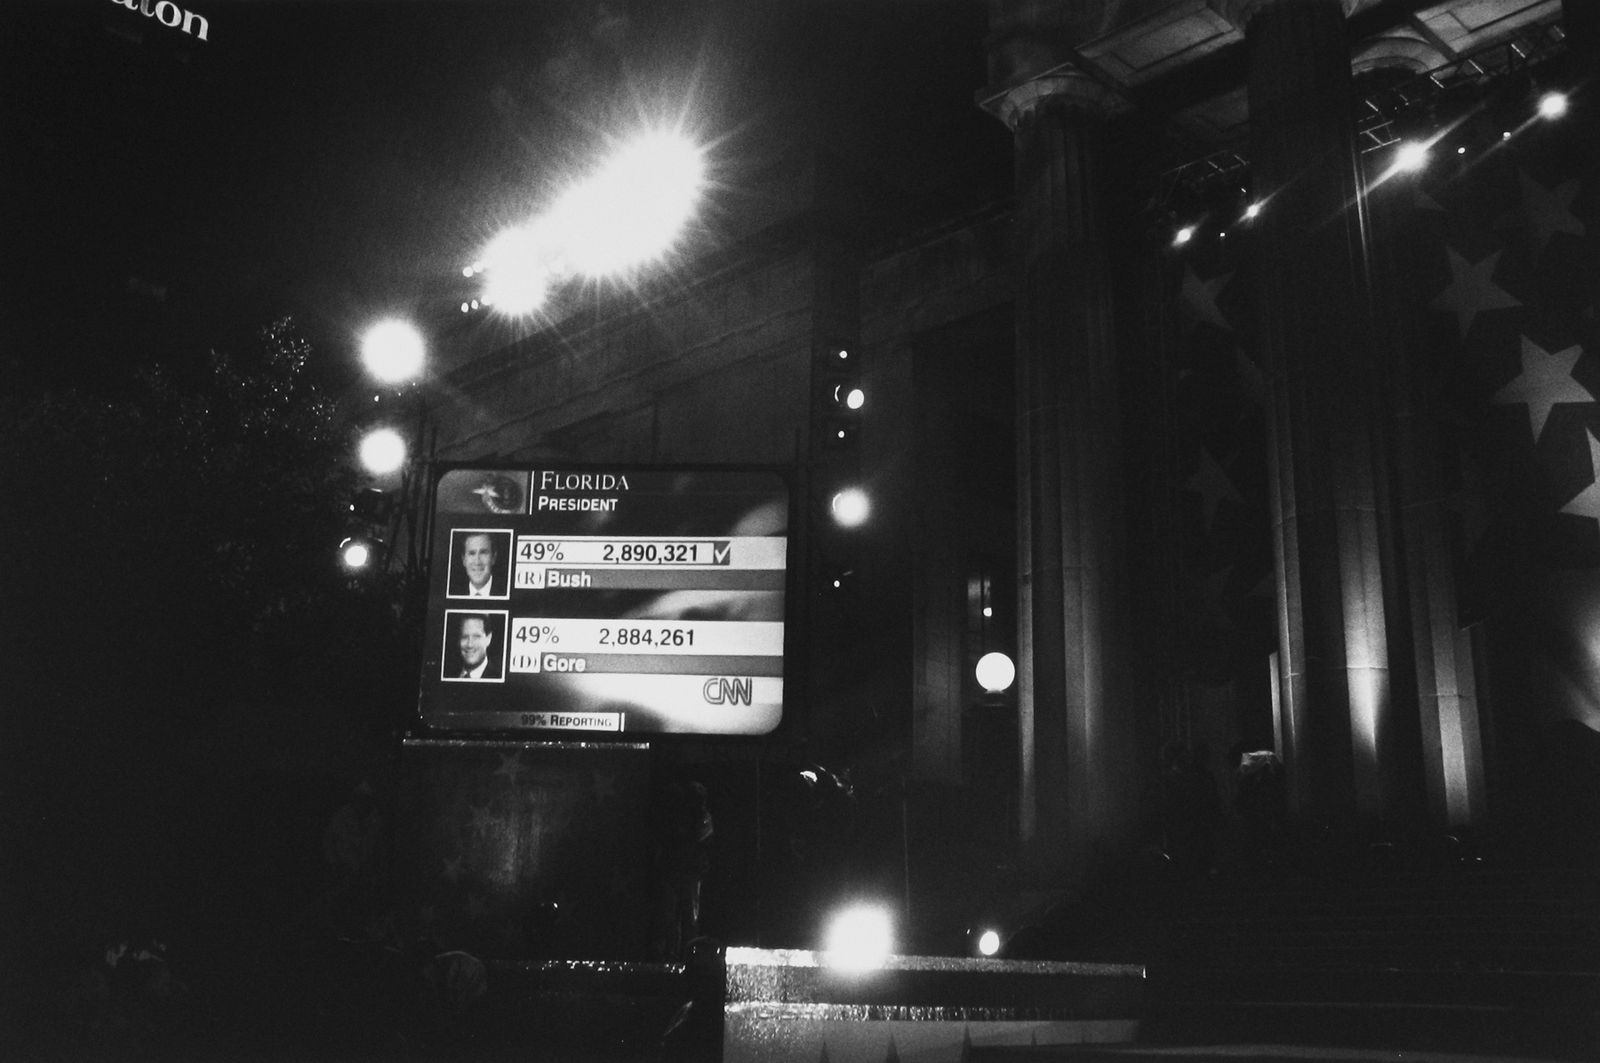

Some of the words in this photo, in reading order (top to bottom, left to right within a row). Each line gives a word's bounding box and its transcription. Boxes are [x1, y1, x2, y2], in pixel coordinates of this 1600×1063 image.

[540, 470, 630, 491] FLORIDA
[538, 495, 618, 512] PRESIDENT
[520, 542, 564, 561] 49%
[602, 544, 698, 565] 2,890,321
[517, 570, 542, 586] (R)
[547, 570, 591, 588] Bush
[515, 625, 560, 644] 49%
[599, 628, 695, 648] 2,884,261
[512, 654, 537, 670] (D)
[543, 653, 587, 673] Gore
[702, 677, 753, 706] CNN
[521, 713, 546, 727] 99%
[550, 714, 612, 727] REPORTING
